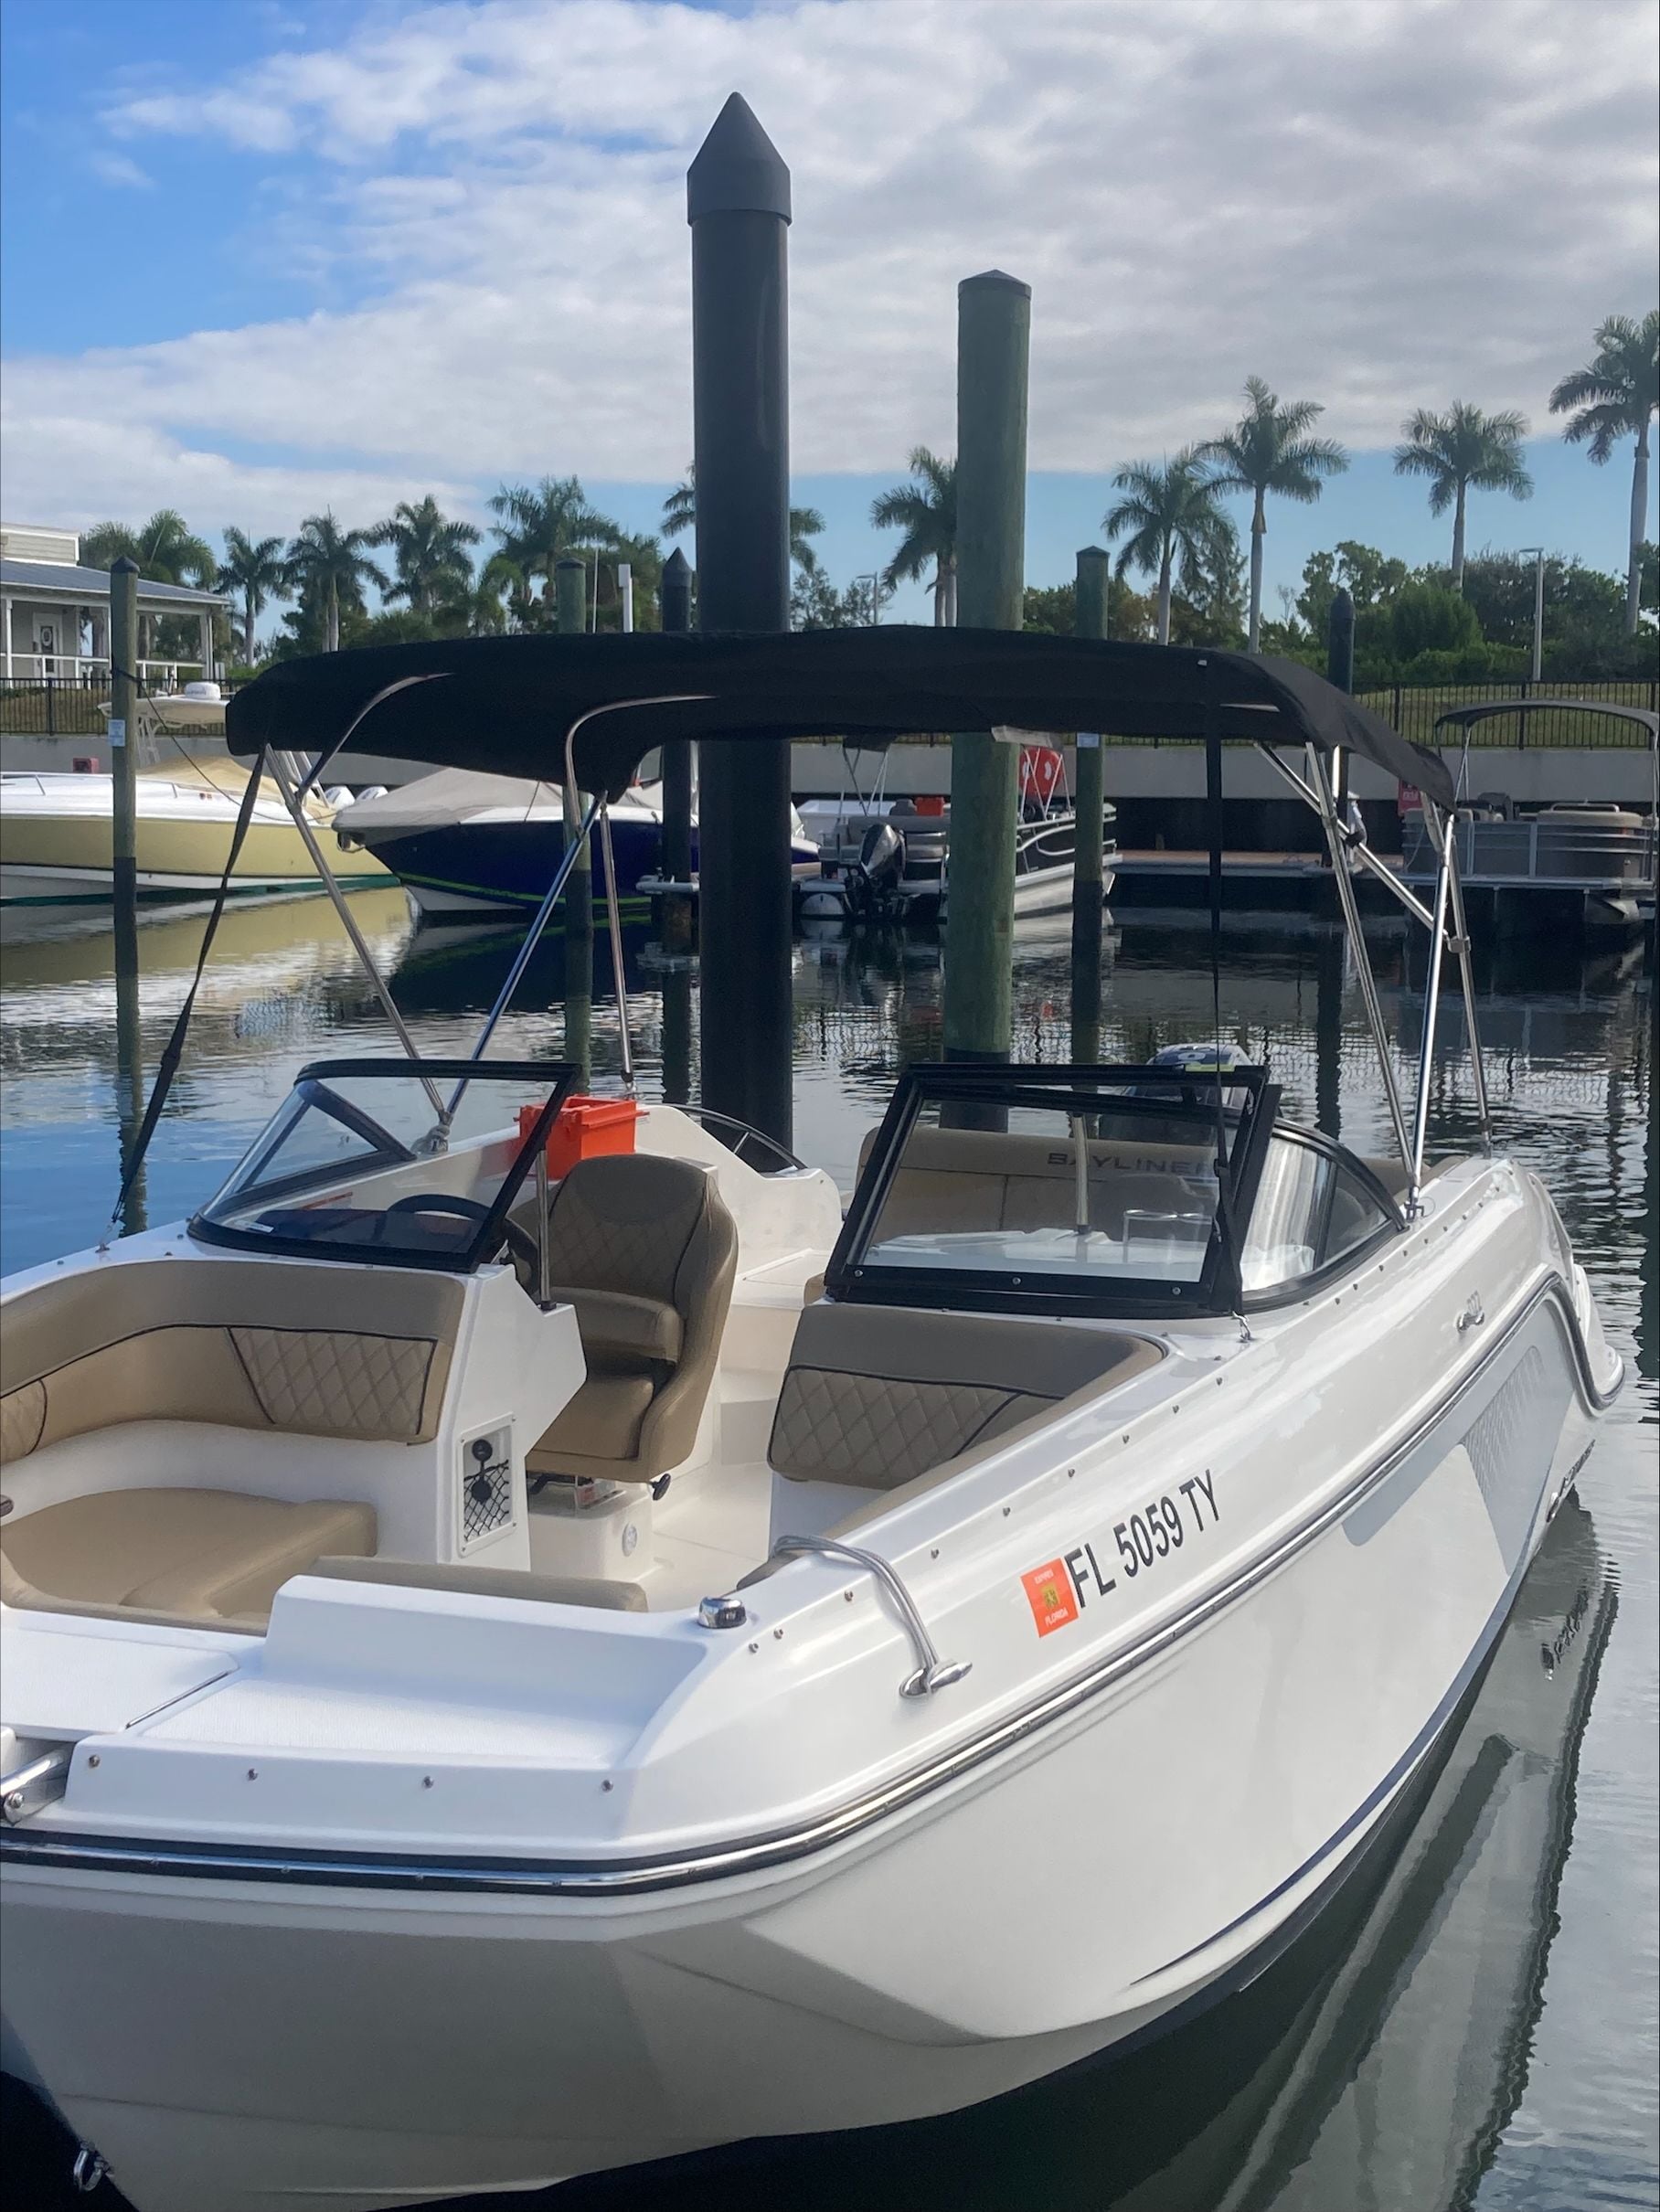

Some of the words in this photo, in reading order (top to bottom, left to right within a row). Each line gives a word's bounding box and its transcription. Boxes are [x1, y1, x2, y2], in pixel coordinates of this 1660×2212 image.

[1048, 1153, 1208, 1175] BYLINE
[1063, 1543, 1117, 1609] FL
[1112, 1495, 1184, 1578] 5059
[1179, 1469, 1219, 1532] TY
